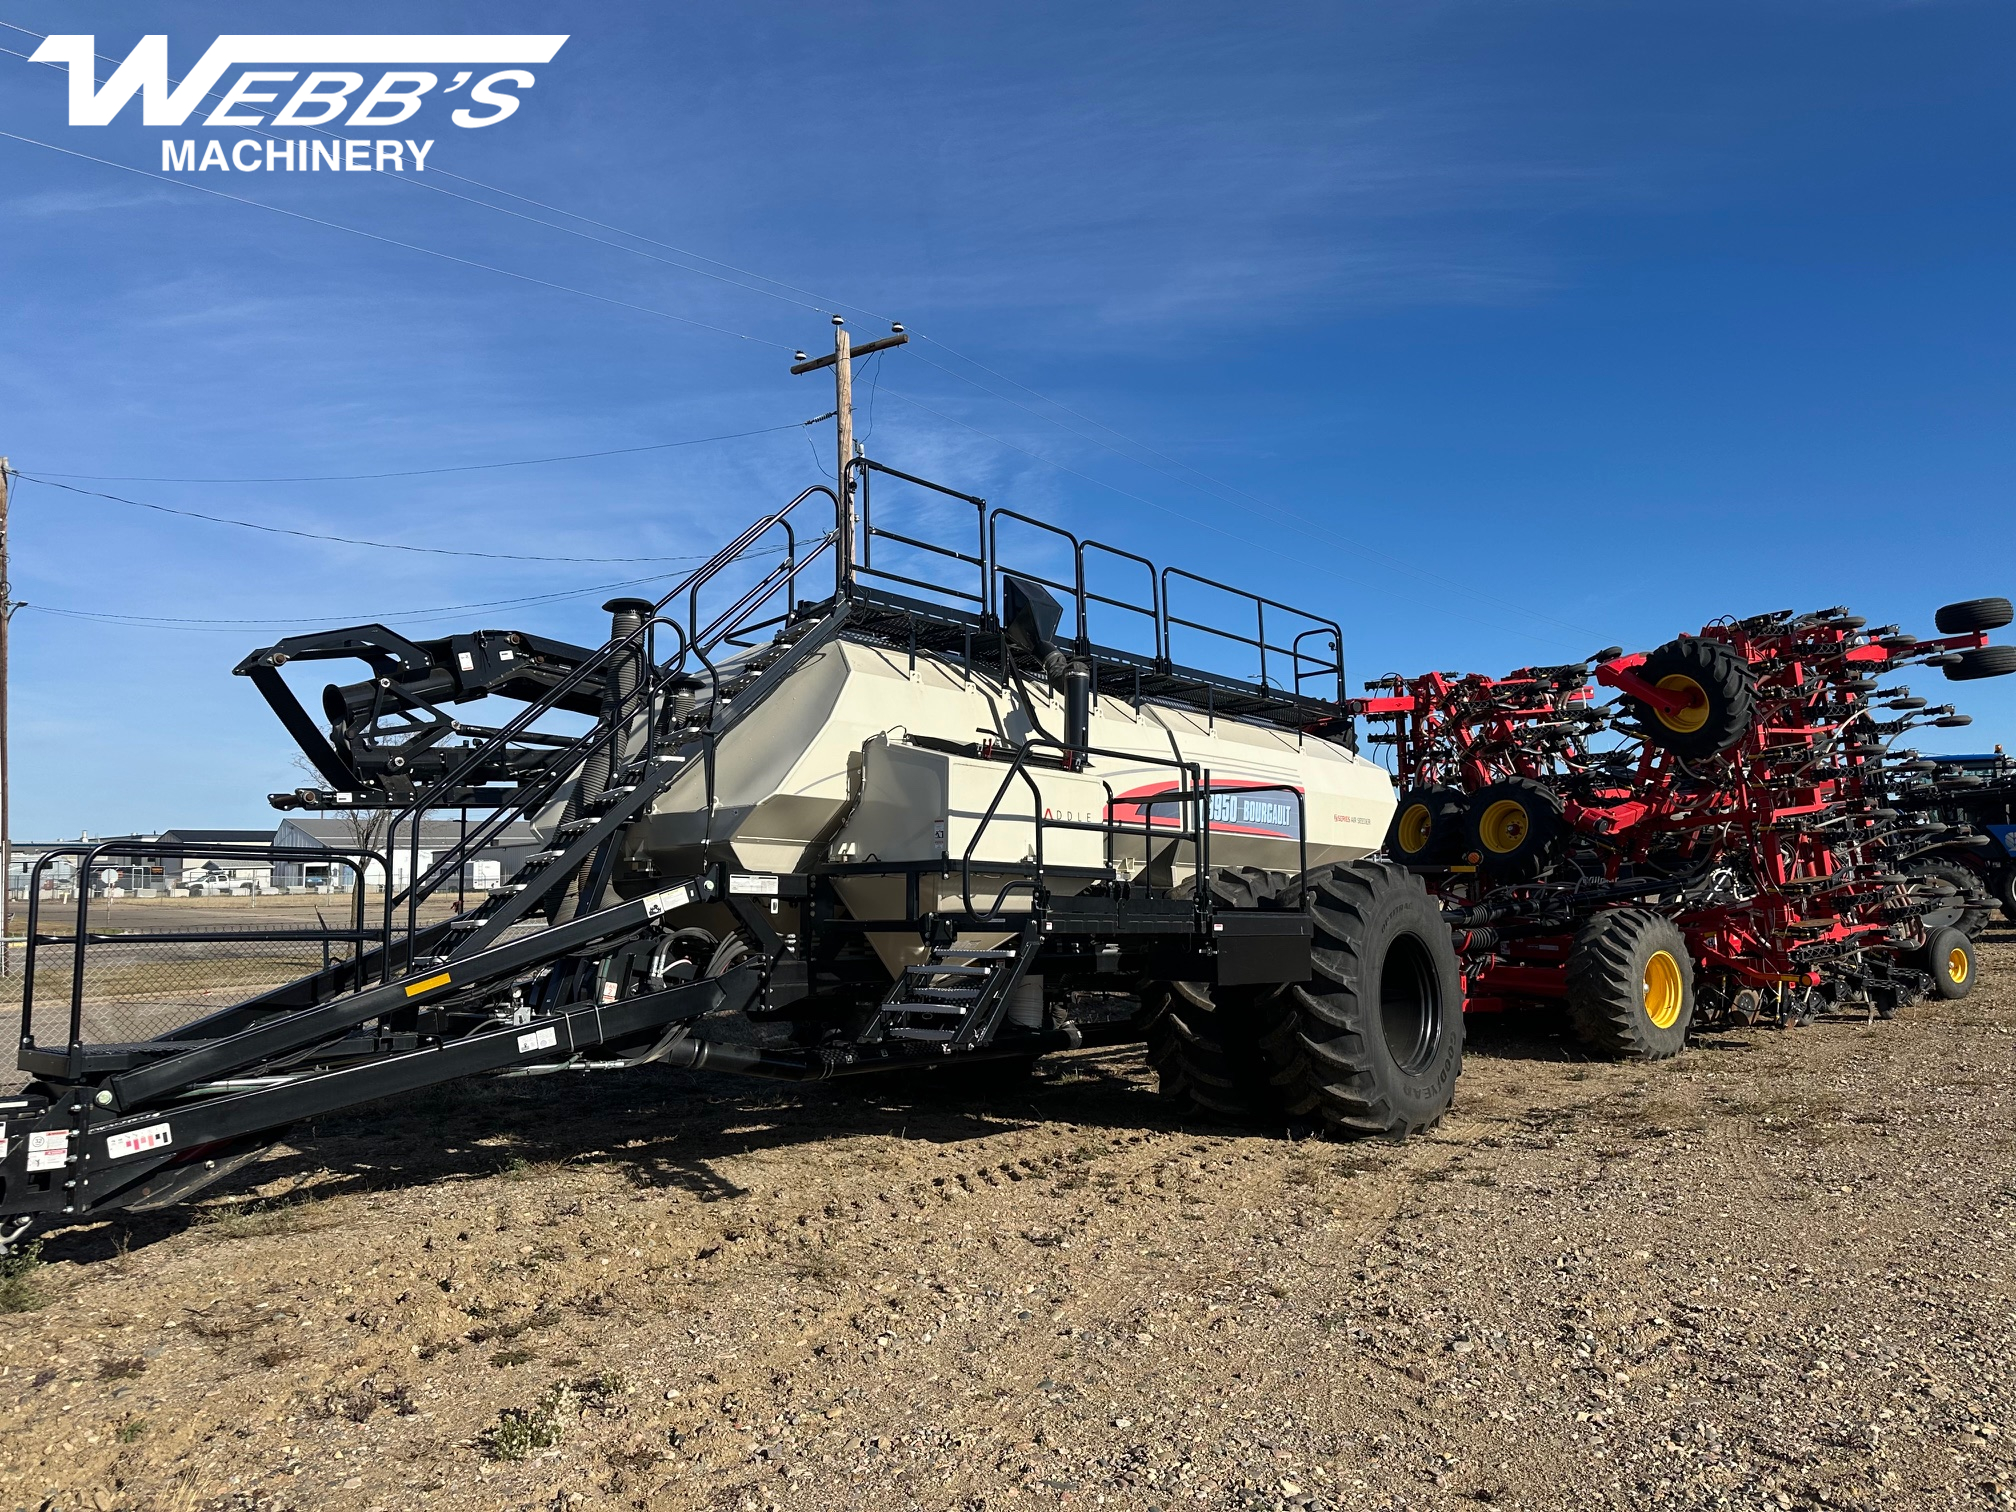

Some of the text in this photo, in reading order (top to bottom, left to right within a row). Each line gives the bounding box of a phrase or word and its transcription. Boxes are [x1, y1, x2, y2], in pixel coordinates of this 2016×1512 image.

[1043, 808, 1091, 822] ADDLE
[1243, 800, 1291, 826] BOURGAULT
[1403, 1030, 1457, 1099] GOODYEAR
